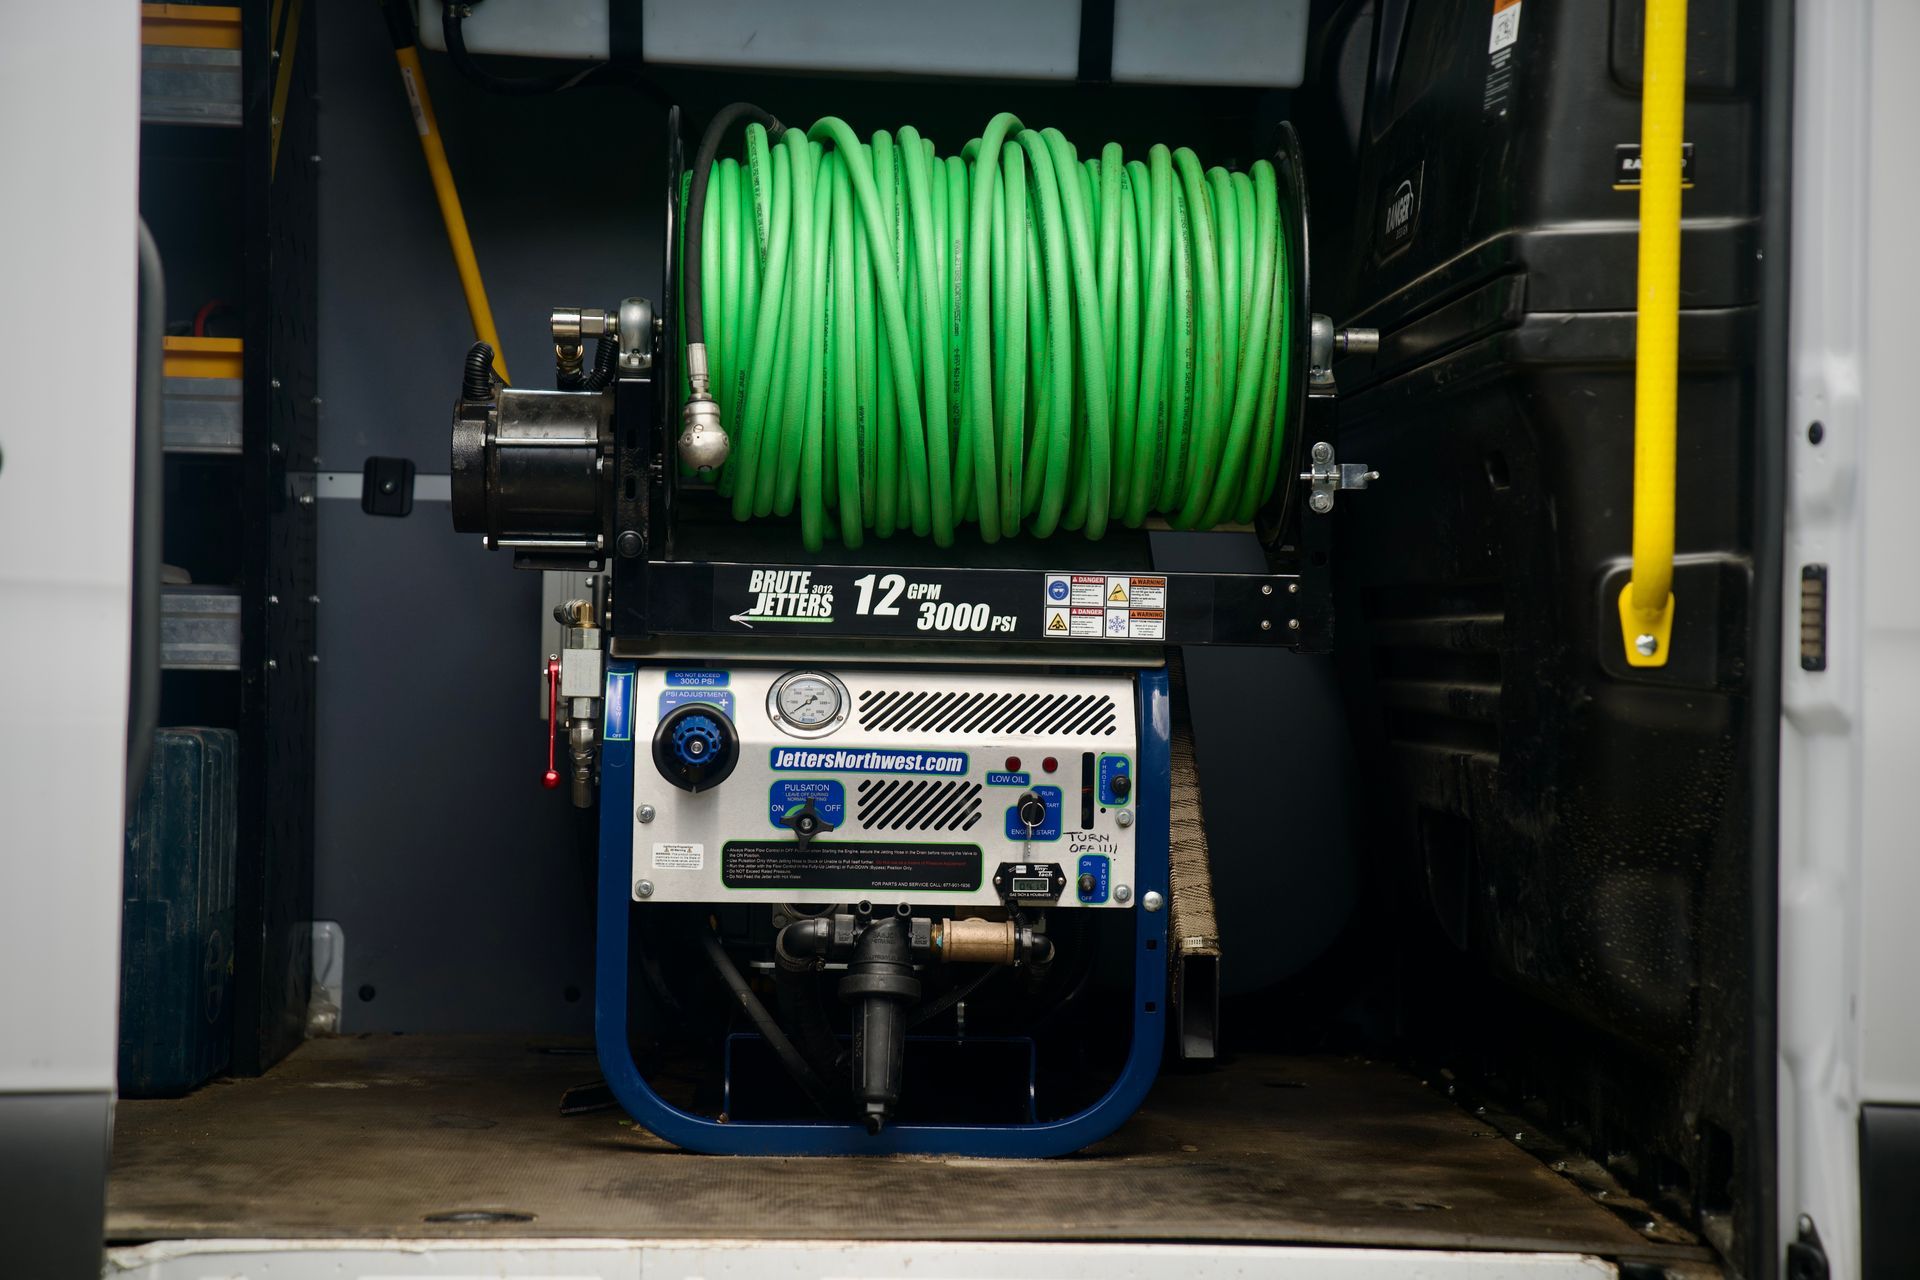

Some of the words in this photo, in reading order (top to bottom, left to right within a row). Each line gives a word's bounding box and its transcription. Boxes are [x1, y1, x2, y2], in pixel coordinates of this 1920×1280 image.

[748, 570, 812, 593] BRUTE
[812, 585, 834, 594] 3012
[748, 593, 834, 617] JETTERS
[854, 574, 906, 616] 12
[907, 583, 942, 600] GPM
[917, 602, 990, 632] 3000
[990, 616, 1017, 632] PSI
[775, 750, 962, 772] JettersNorthwest.com
[1063, 832, 1109, 842] TURN
